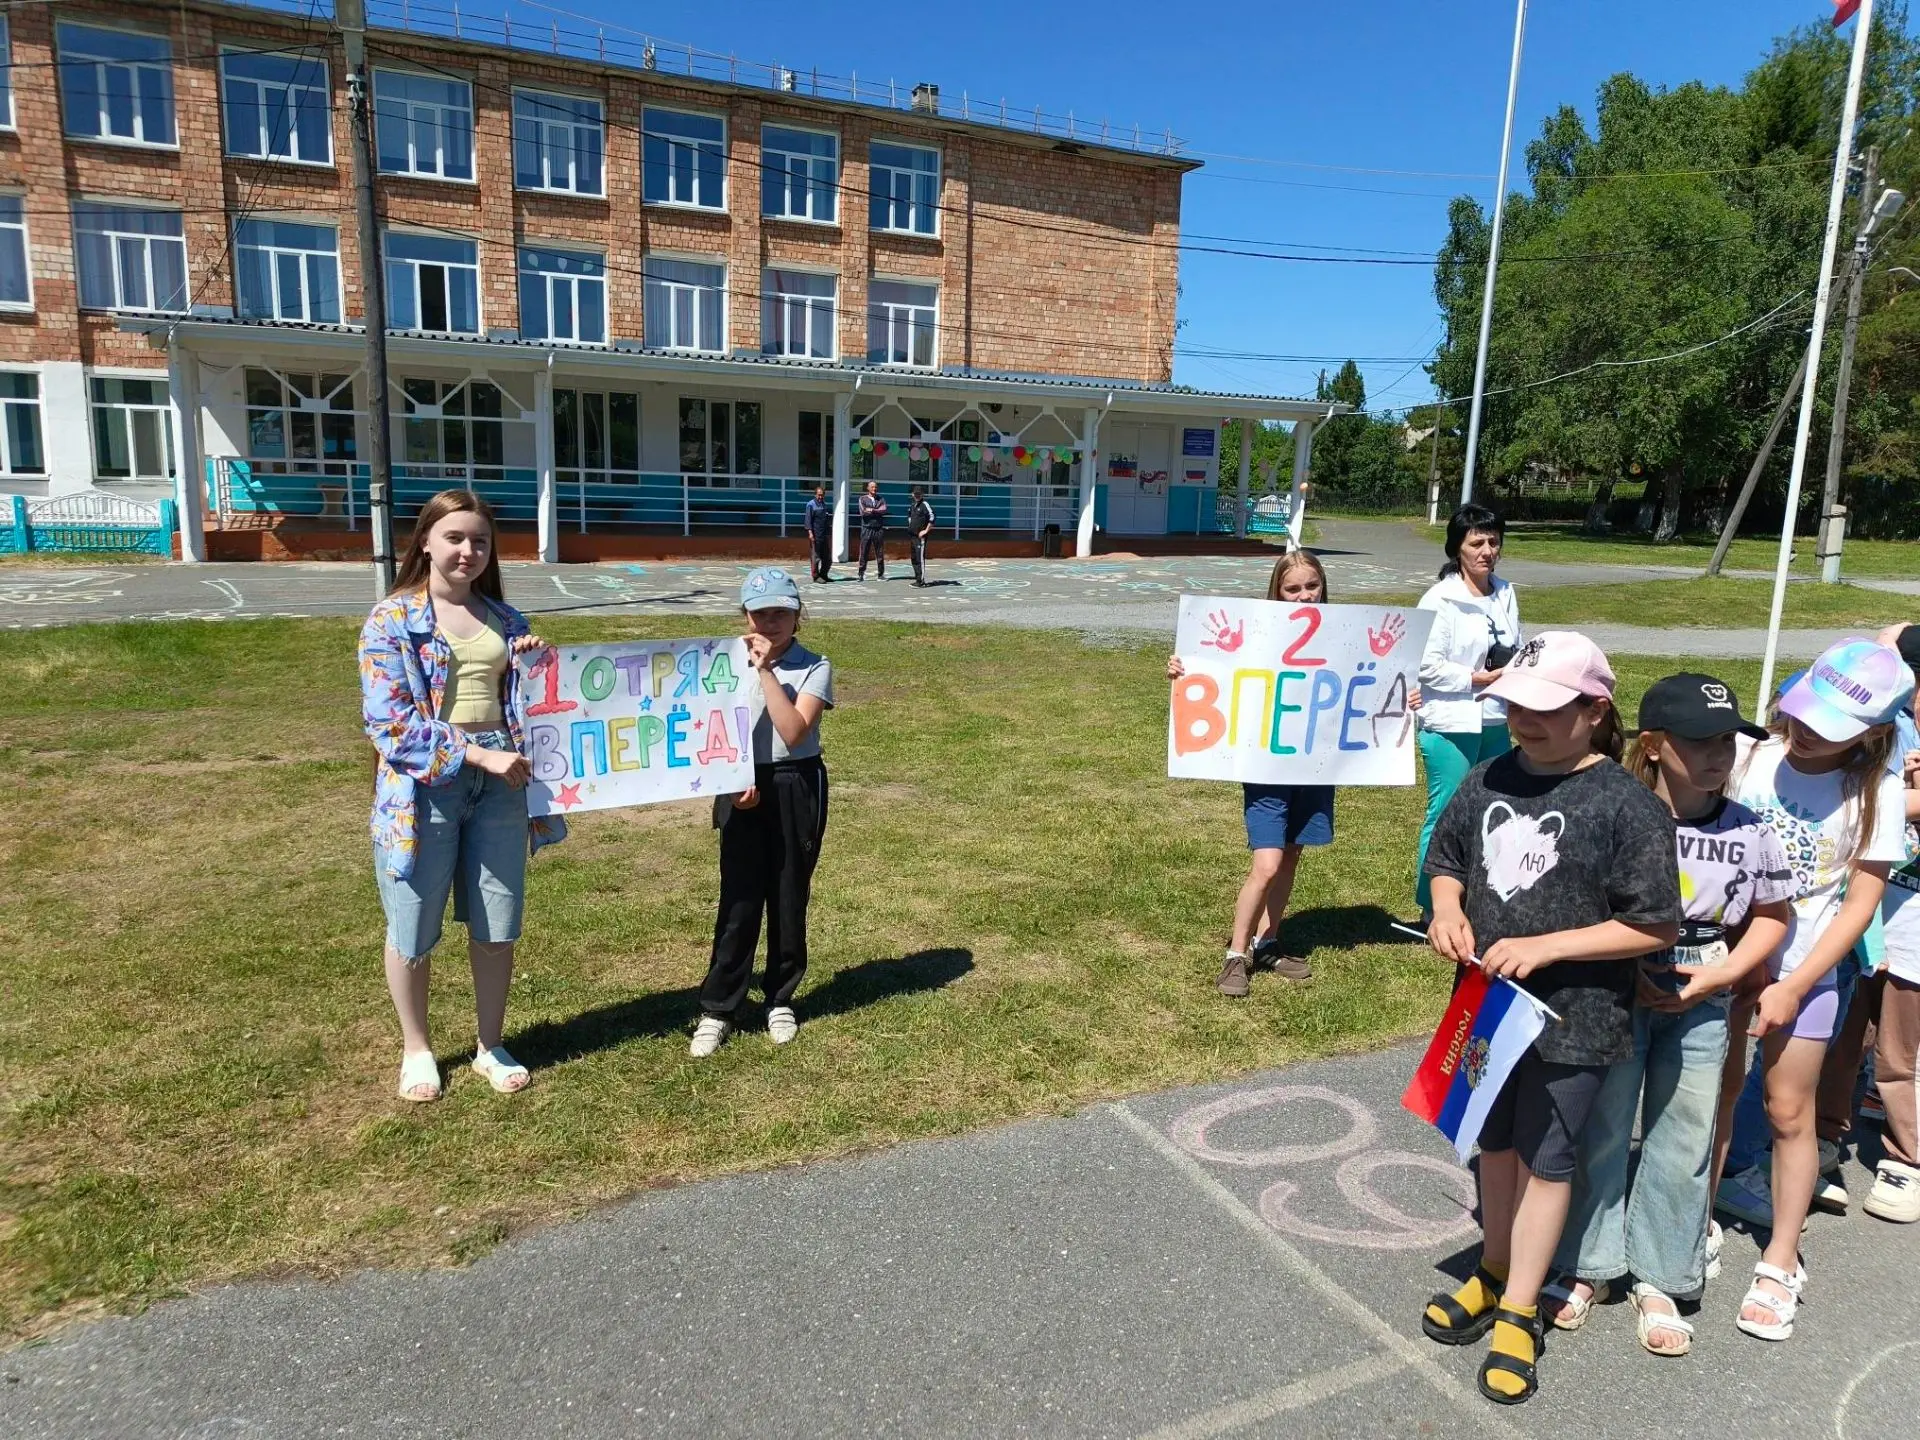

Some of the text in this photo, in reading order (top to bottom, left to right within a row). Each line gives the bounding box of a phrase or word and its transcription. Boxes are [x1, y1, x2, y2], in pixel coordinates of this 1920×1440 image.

[1282, 606, 1327, 666] 2
[525, 645, 740, 717] 1 ОТРЯД
[1172, 662, 1411, 757] ВПЕРЁД
[530, 703, 750, 783] ВПЕРЁД!
[1678, 834, 1746, 865] VING
[1440, 1008, 1472, 1076] РОССИЯ
